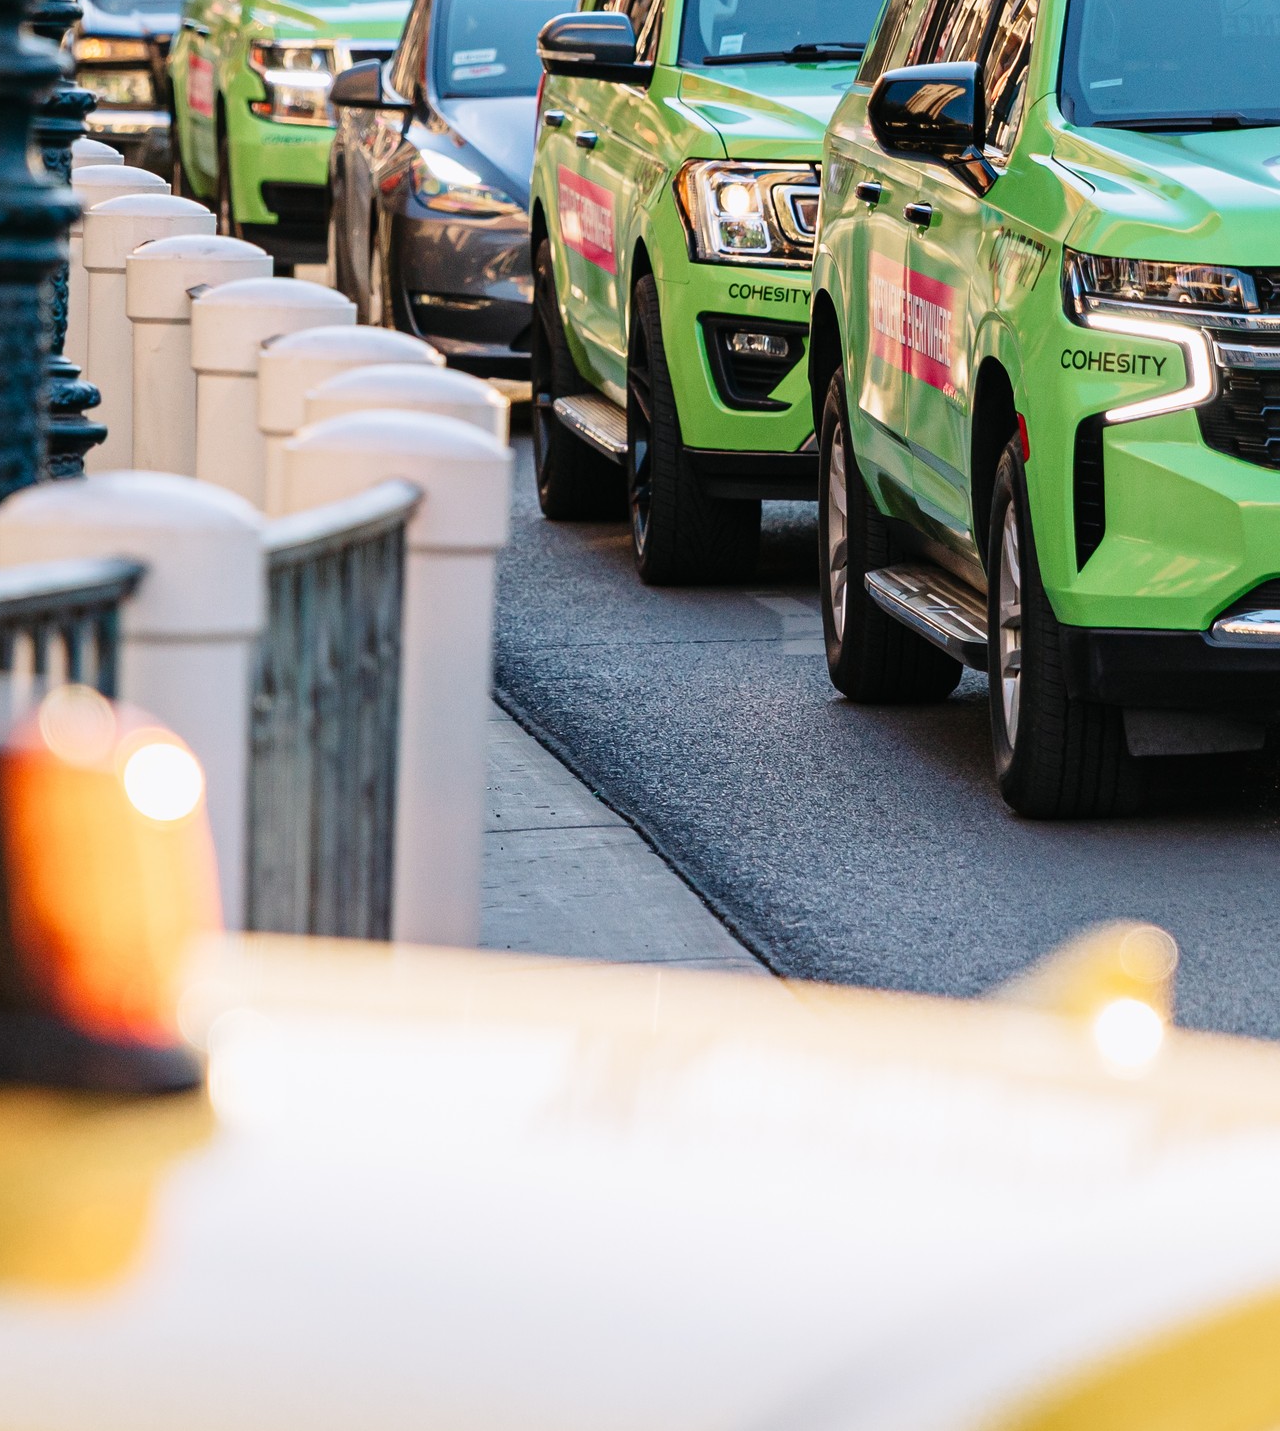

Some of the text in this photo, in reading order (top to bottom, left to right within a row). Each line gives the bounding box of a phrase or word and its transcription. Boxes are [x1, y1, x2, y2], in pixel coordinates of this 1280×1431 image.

[988, 226, 1052, 292] COHESITY
[728, 283, 811, 305] COHESITY
[873, 274, 952, 368] RESILIENCE EVERYWHERE
[1060, 348, 1167, 376] COHESITY
